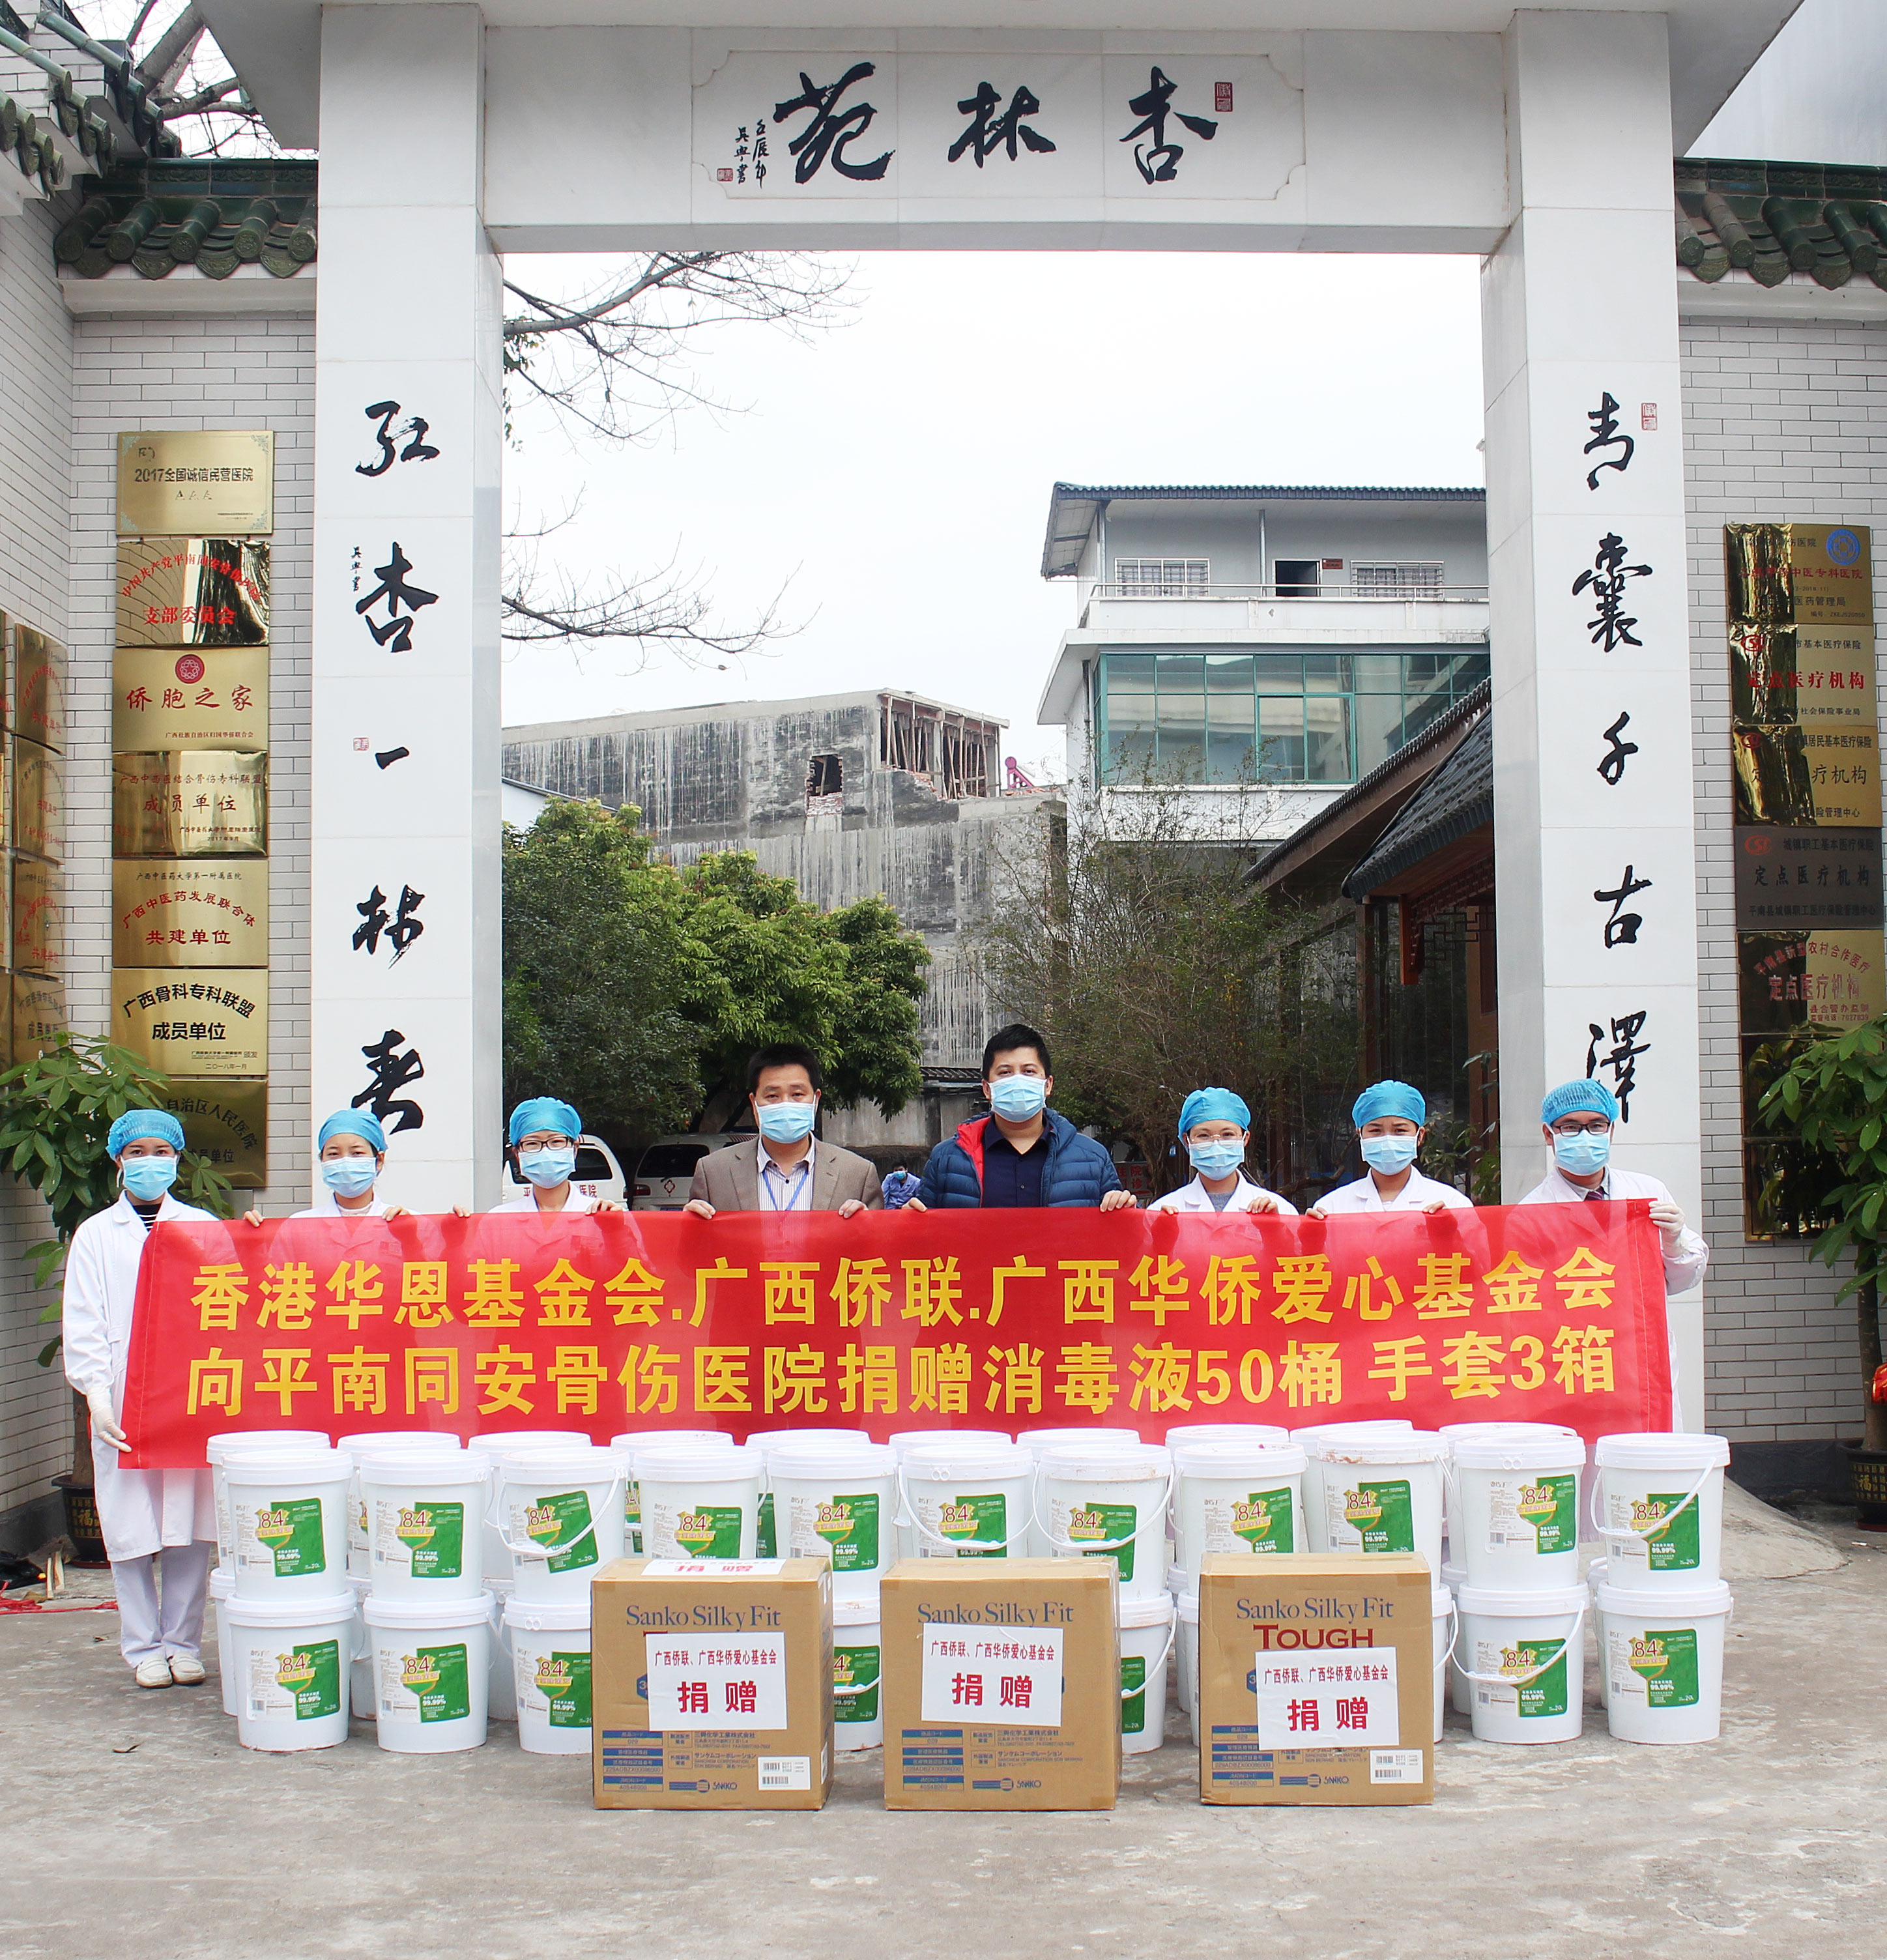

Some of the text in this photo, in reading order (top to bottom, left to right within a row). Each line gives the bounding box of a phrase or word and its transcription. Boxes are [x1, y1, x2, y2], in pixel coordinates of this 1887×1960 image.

[134, 468, 253, 482] 2017全国诚信民营医院
[143, 606, 236, 625] 支部委员会
[1746, 670, 1865, 689] 定点医疗机构
[126, 685, 253, 712] 侨胞之家
[143, 793, 237, 814] 成员单位
[136, 872, 242, 880] 广西中医药大学第一附属医院
[1754, 865, 1870, 886] 定点医疗机构
[122, 891, 255, 929] 广西中医药发展联合体
[146, 929, 231, 945] 共建单位
[1768, 974, 1860, 1001] 定点医疗机构
[122, 983, 255, 1018] 广西骨科专科联盟
[152, 1022, 226, 1041] 成员单位
[167, 1098, 258, 1149] 自治区人民医院
[186, 1325, 1615, 1417] 向平南同安骨伤医院捐赠消毒液50桶 手套3箱
[1349, 1492, 1371, 1510] 84
[1525, 1486, 1548, 1505] 84
[261, 1510, 284, 1528] 84
[402, 1511, 425, 1528] 84
[529, 1506, 551, 1526] 84
[822, 1505, 844, 1522] 84
[945, 1505, 968, 1523] 84
[1074, 1512, 1097, 1528] 84
[1238, 1501, 1262, 1521] 84
[1637, 1502, 1660, 1520] 84
[683, 1514, 706, 1531] 84
[626, 1605, 781, 1630] Sanko Silky Fit
[917, 1602, 1074, 1626] Sanko Silky Fit
[1237, 1597, 1393, 1624] Sanko Silky Fit
[1253, 1624, 1374, 1649] TOUGH
[654, 1649, 777, 1666] 广西侨联、广西华侨爱心基金会
[931, 1640, 1054, 1661] 广西侨联、广西华侨爱心基金会
[1635, 1640, 1658, 1658] 84
[282, 1656, 306, 1673] 84
[406, 1655, 429, 1673] 84
[540, 1660, 564, 1677] 84
[1506, 1650, 1530, 1668] 84
[1265, 1664, 1388, 1685] 广西侨联、广西华侨爱心基金会
[678, 1680, 757, 1714] 捐赠
[952, 1672, 1032, 1708] 捐赠
[1287, 1697, 1368, 1731] 捐赠
[1324, 1776, 1349, 1784] SANKO
